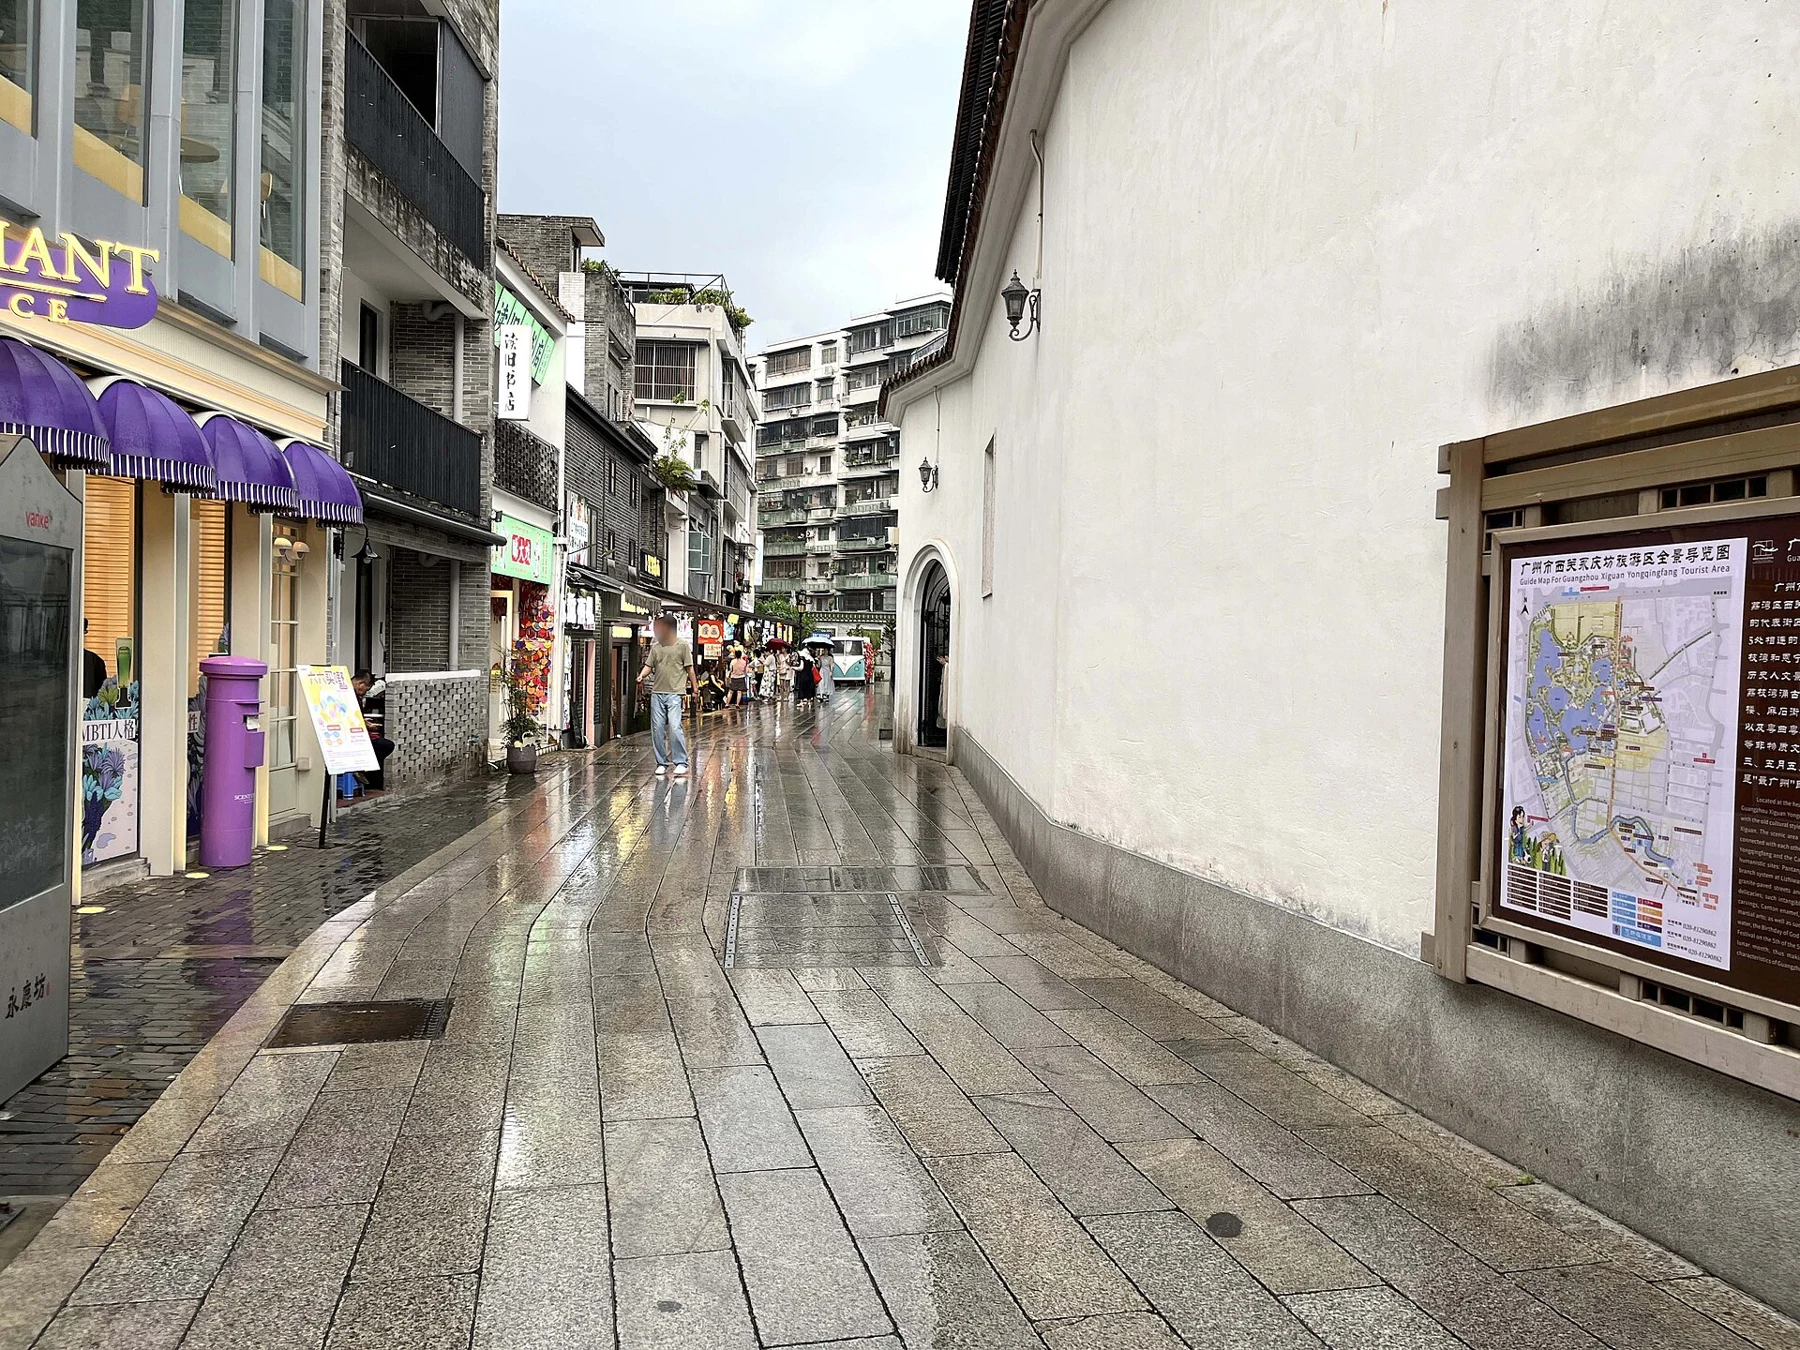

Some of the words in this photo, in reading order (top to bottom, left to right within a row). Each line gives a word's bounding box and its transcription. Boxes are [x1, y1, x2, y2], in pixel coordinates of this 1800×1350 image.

[25, 511, 49, 529] vanke
[1520, 544, 1731, 576] 广州市西关永庆坊旅游区全景导览图
[1520, 577, 1537, 586] Guide
[1537, 576, 1551, 586] Map
[1551, 575, 1562, 584] For
[1562, 573, 1599, 584] Guangzhou
[1601, 571, 1625, 582] Xiguan
[1627, 567, 1678, 579] Yongqingfang
[1681, 565, 1709, 575] Tourist
[1711, 564, 1730, 573] Area
